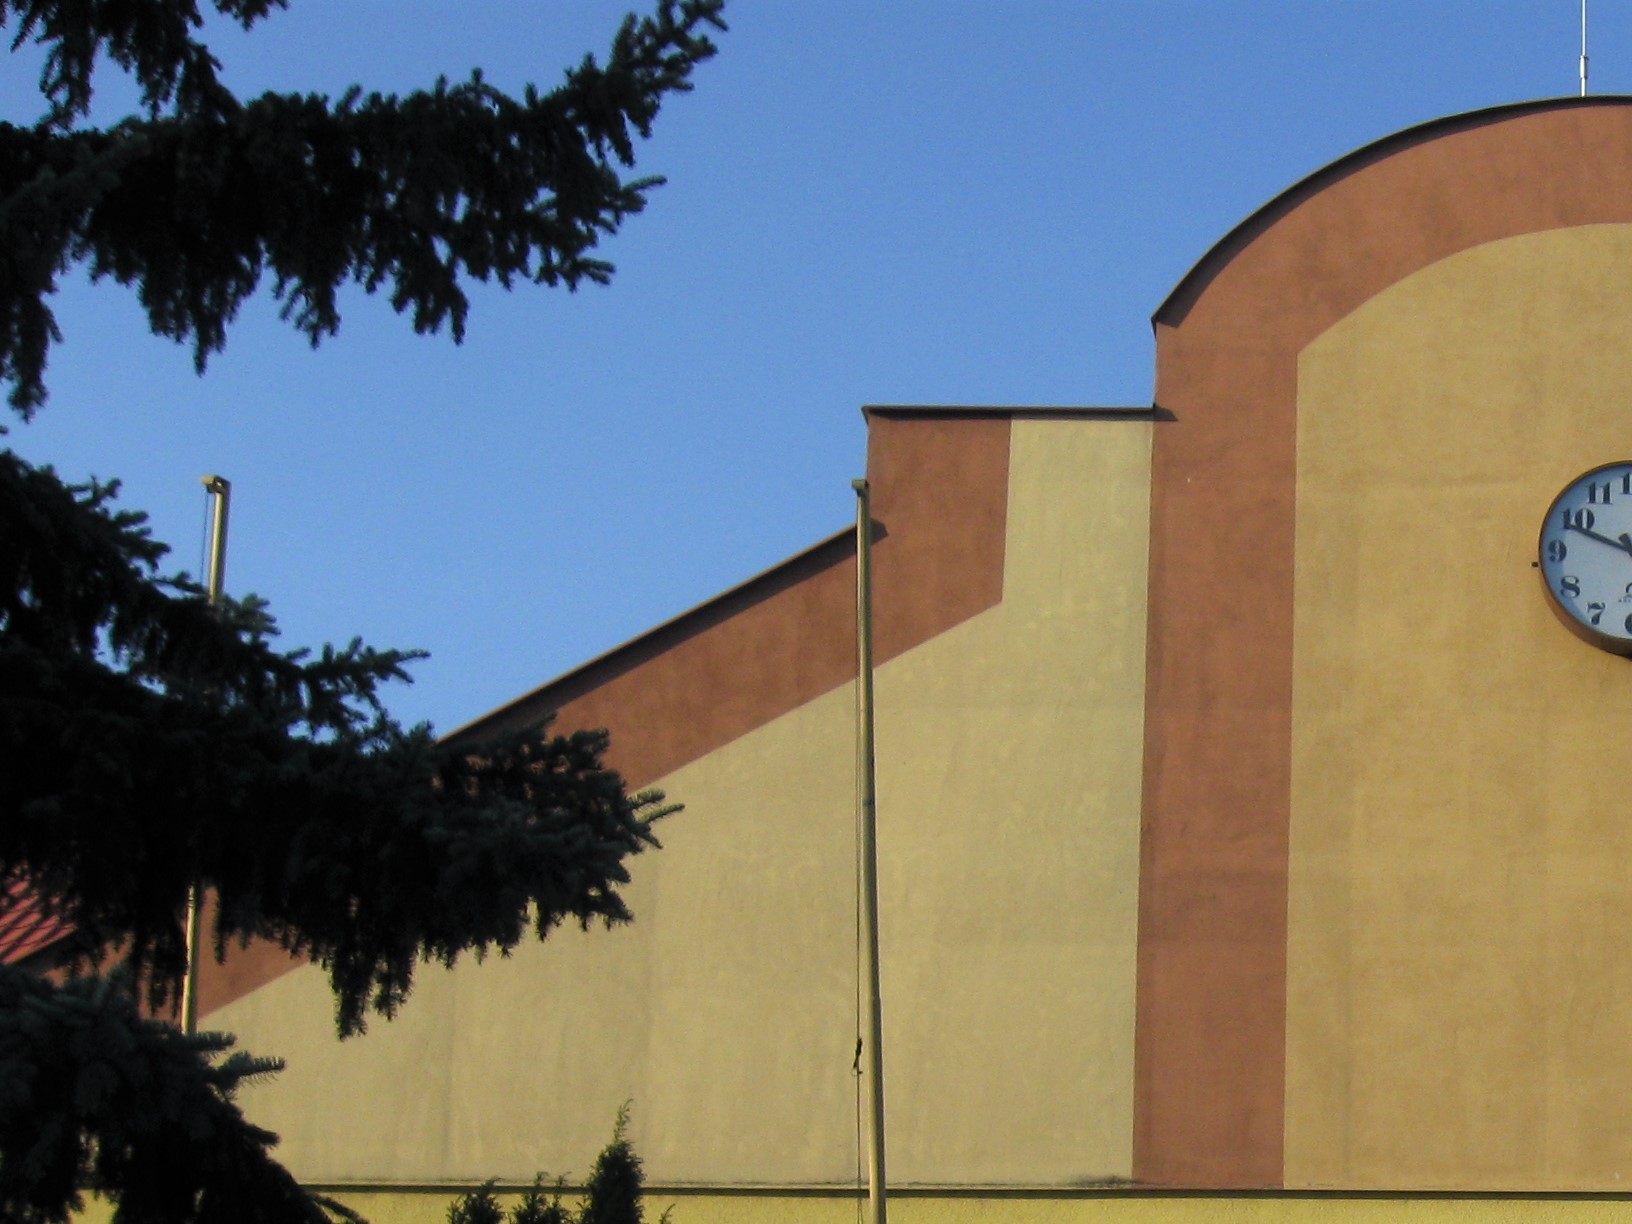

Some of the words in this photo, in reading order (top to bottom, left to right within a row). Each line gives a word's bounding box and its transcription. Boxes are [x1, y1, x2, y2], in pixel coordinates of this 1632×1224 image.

[1587, 481, 1613, 505] 11
[1562, 508, 1595, 530] 10
[1549, 539, 1567, 562] 9
[1560, 575, 1580, 598] 8
[1587, 602, 1606, 625] 7
